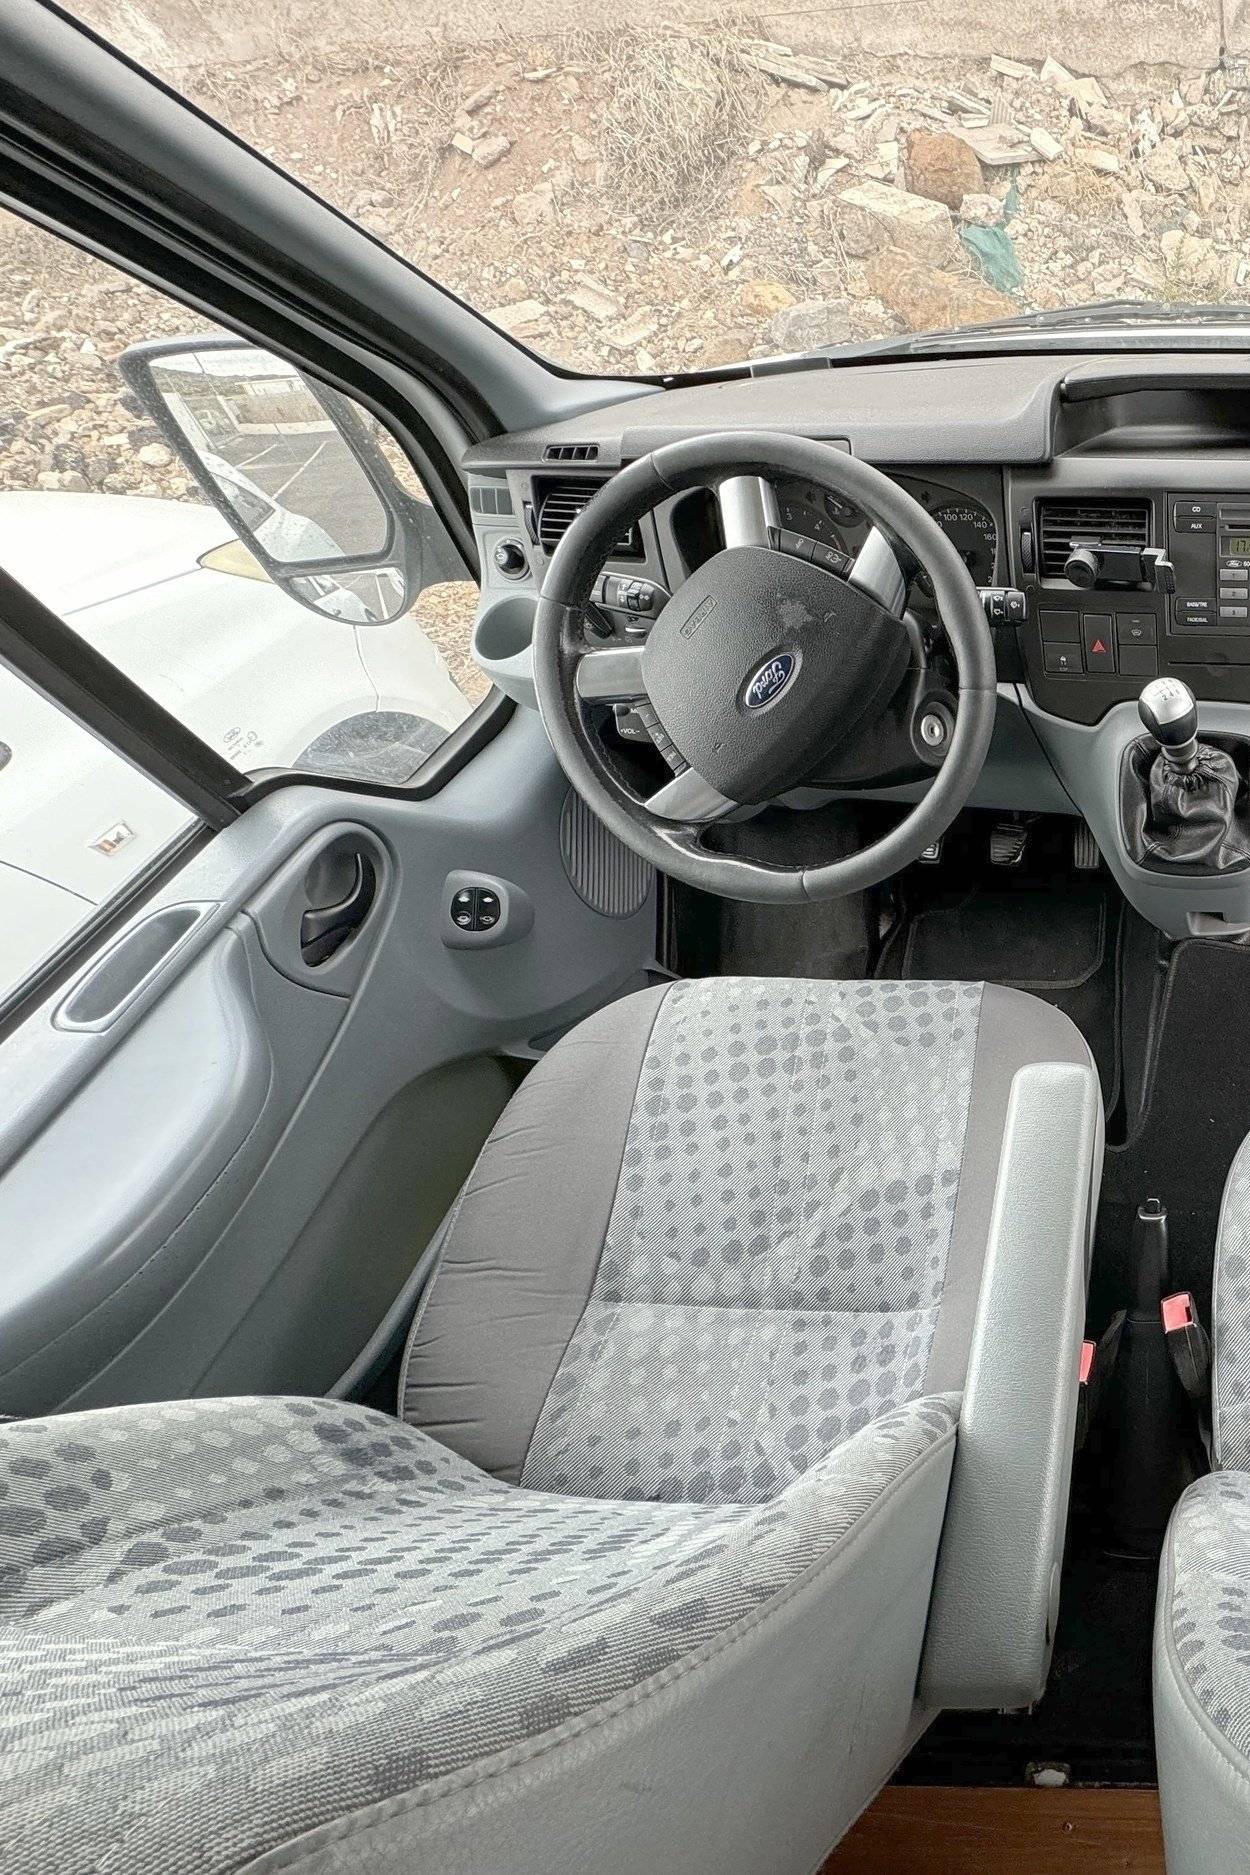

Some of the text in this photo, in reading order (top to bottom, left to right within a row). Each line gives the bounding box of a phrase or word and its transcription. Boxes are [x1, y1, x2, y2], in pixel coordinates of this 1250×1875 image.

[943, 513, 958, 521] 100
[959, 513, 974, 521] 120
[973, 521, 988, 529] 140
[752, 661, 786, 699] Ford
